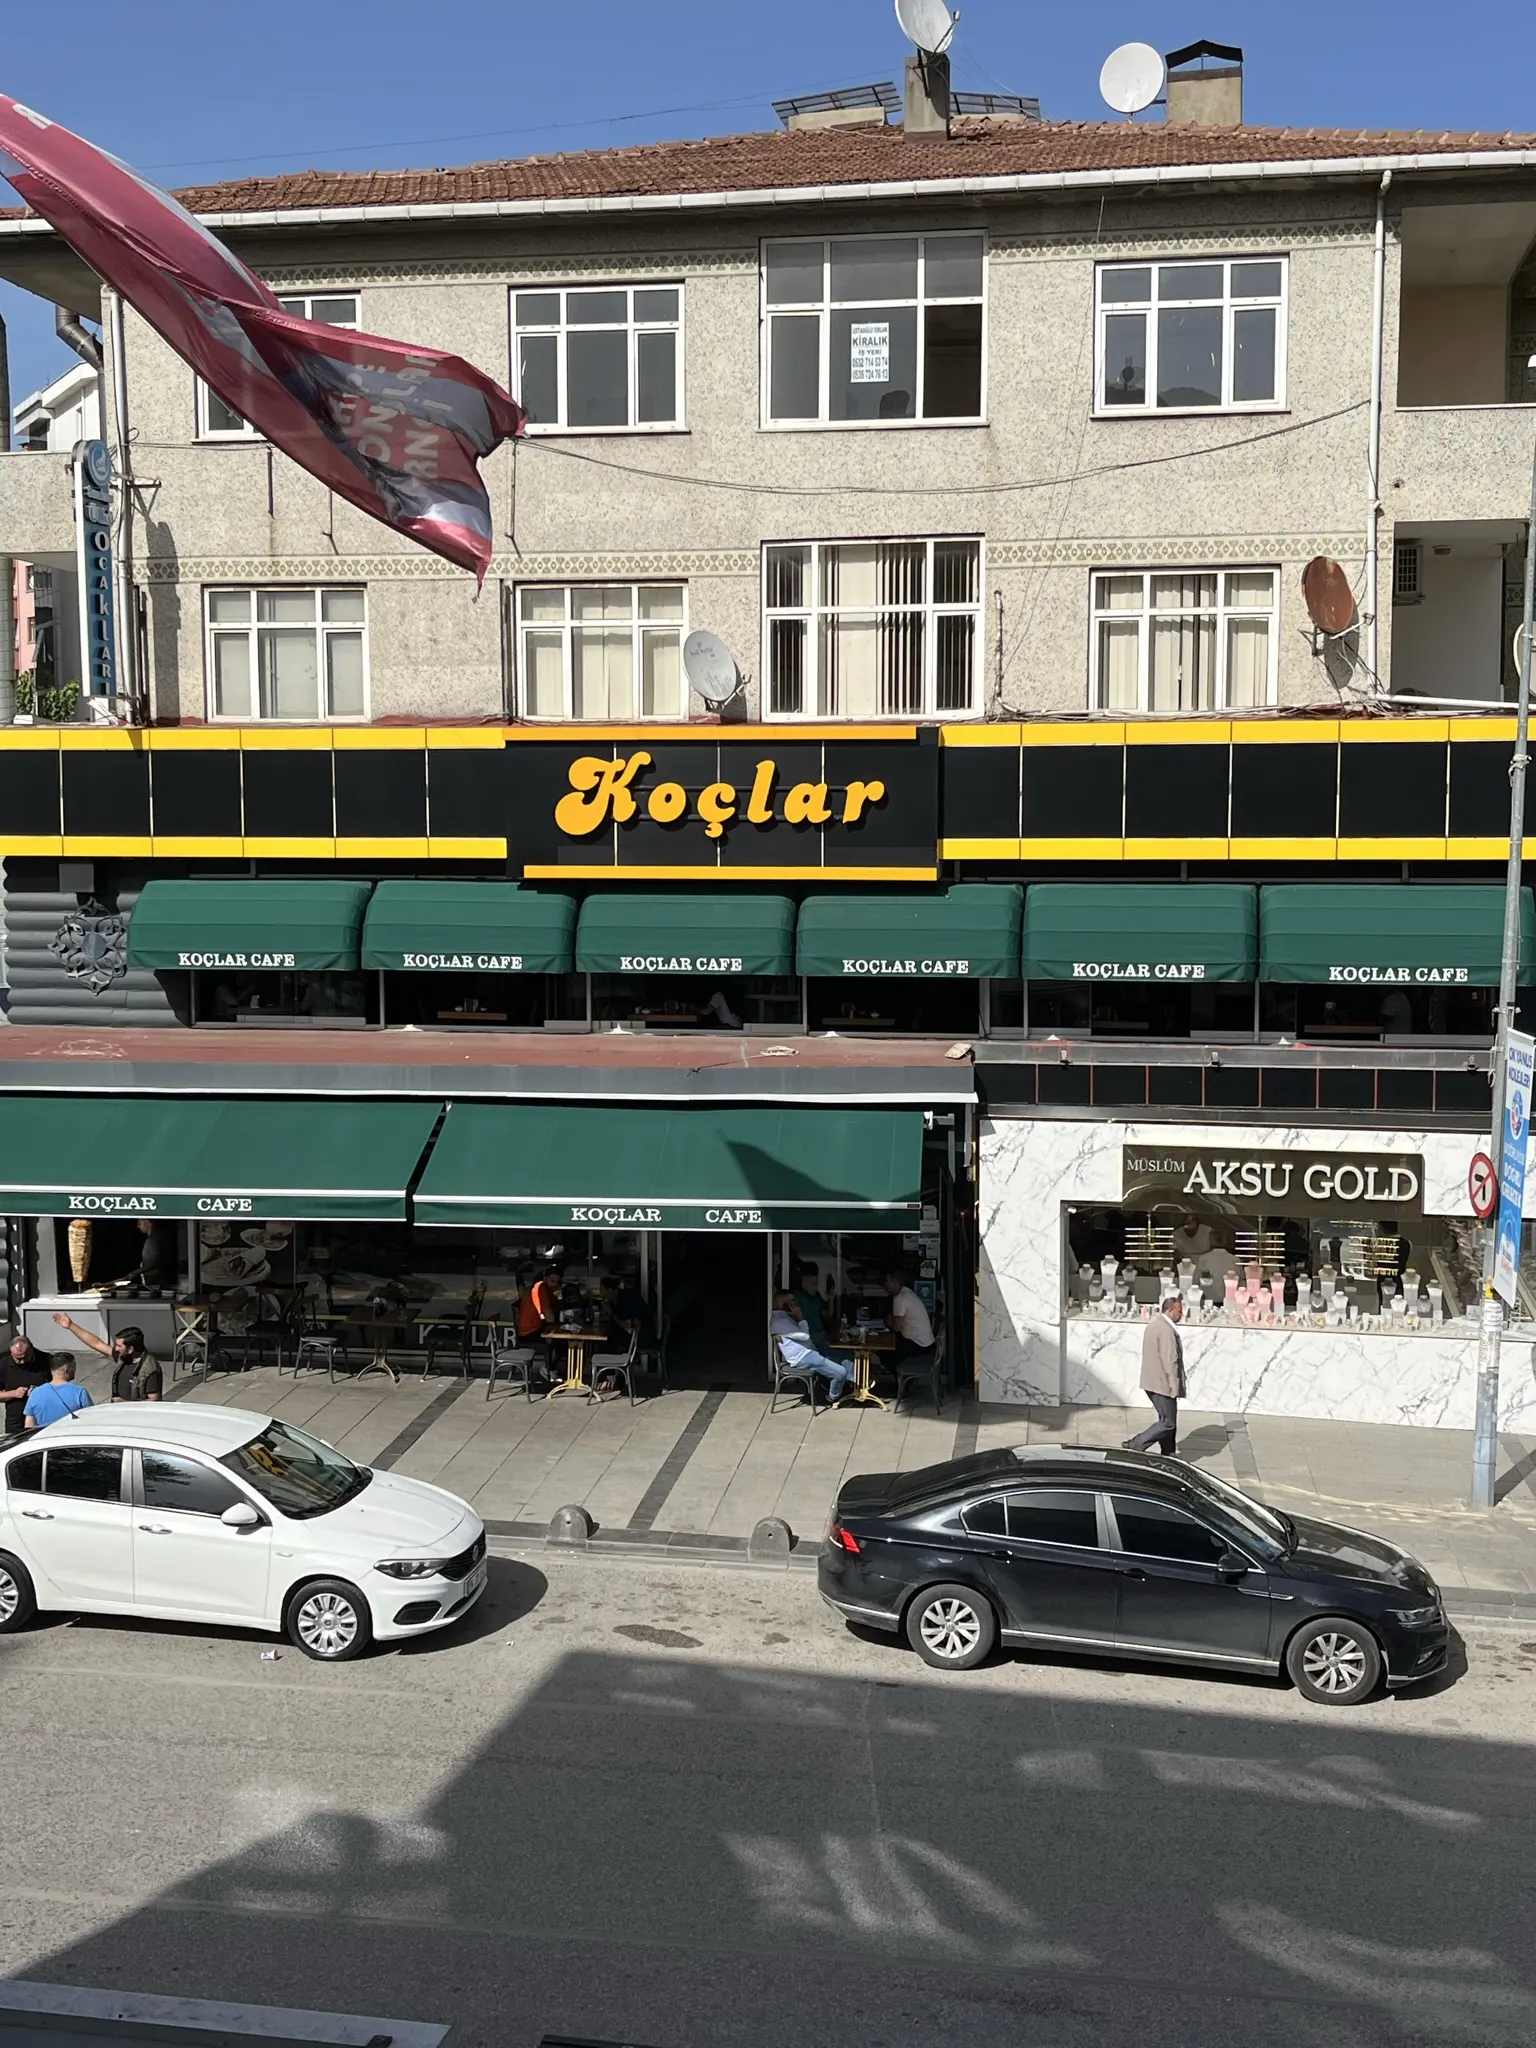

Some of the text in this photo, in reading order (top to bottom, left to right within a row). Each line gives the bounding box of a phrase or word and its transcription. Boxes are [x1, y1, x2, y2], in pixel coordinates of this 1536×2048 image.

[853, 335, 888, 346] KİRALIK
[554, 750, 886, 840] Koçlar
[178, 952, 295, 969] KOÇLAR CAFE
[403, 953, 523, 970] KOÇLAR CAFE
[619, 956, 743, 973] KOÇLAR CAFE
[842, 959, 969, 976] KOÇLAR CAFE
[1072, 962, 1205, 980] KOÇLAR CAFE
[1328, 966, 1469, 984] KOÇLAR CAFE
[1127, 1158, 1418, 1201] MÜSLÜM AKSU GOLD
[69, 1195, 253, 1213] KOÇLAR CAFE
[571, 1207, 762, 1224] KOÇLAR CAFE
[418, 1323, 517, 1348] KLAR
